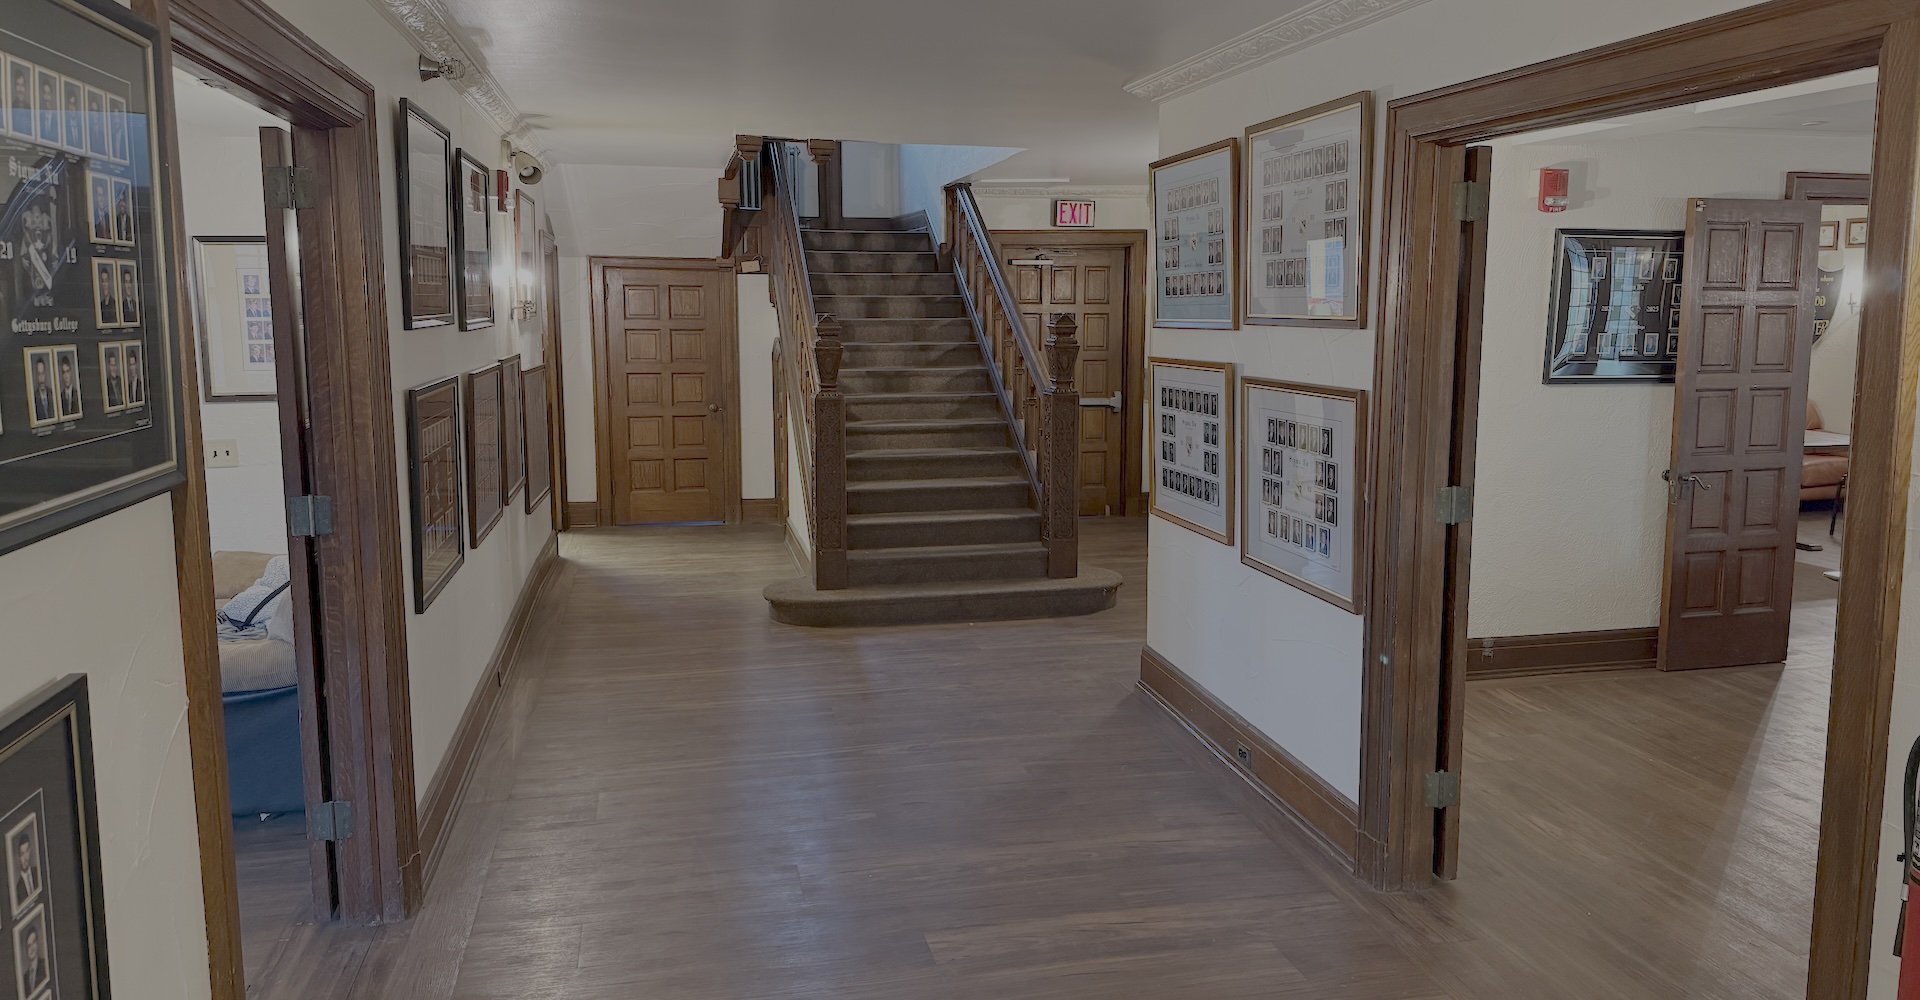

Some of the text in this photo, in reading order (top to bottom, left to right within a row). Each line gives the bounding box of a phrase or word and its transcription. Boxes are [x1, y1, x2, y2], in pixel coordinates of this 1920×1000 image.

[1059, 202, 1092, 225] EXIT
[11, 316, 79, 336] Gettysburg College
